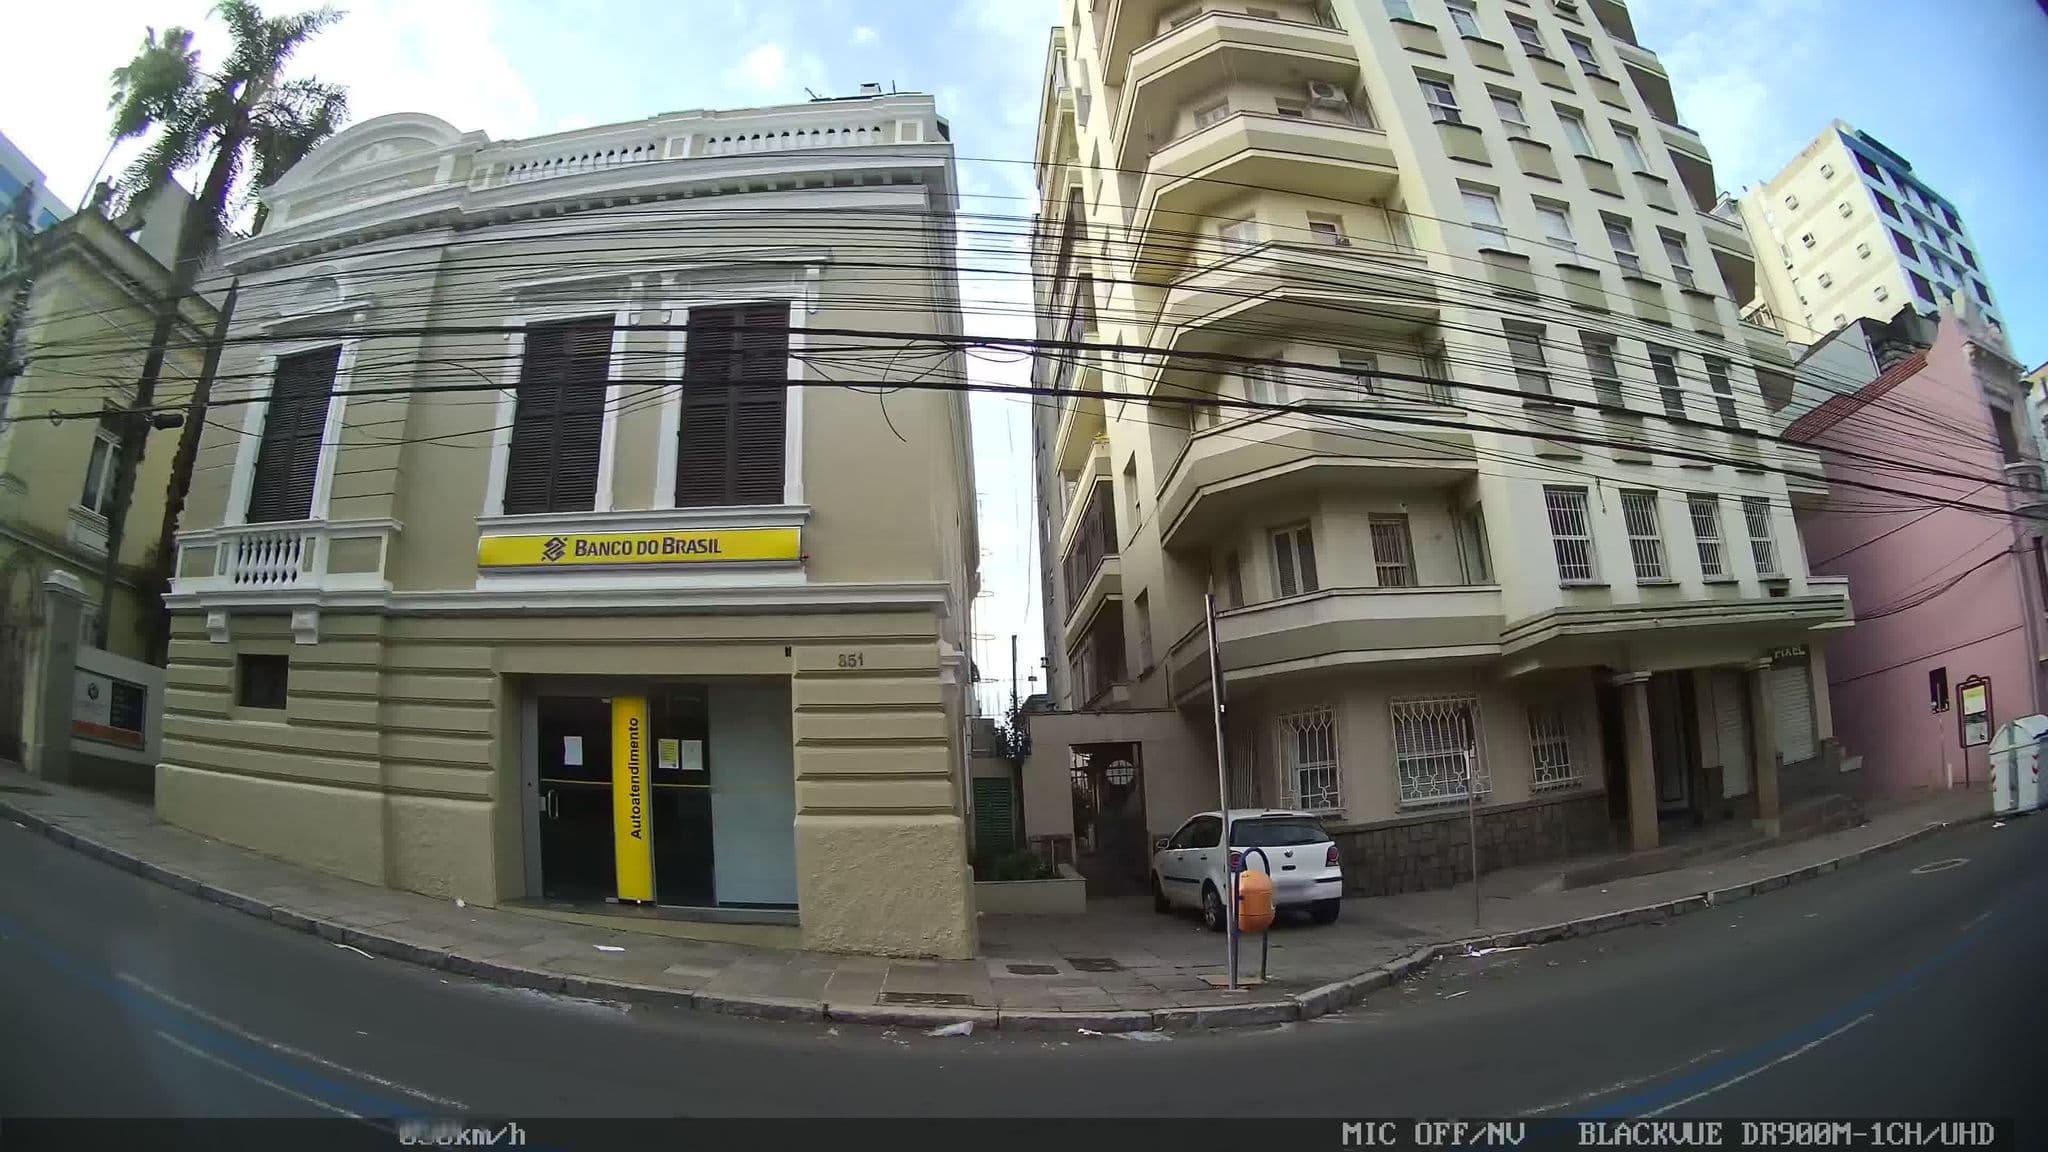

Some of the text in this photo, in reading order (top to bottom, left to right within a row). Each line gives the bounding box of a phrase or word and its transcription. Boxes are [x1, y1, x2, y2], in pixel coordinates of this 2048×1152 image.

[575, 537, 722, 557] BANCO DO BRASIL
[628, 717, 642, 840] Autoatendimento
